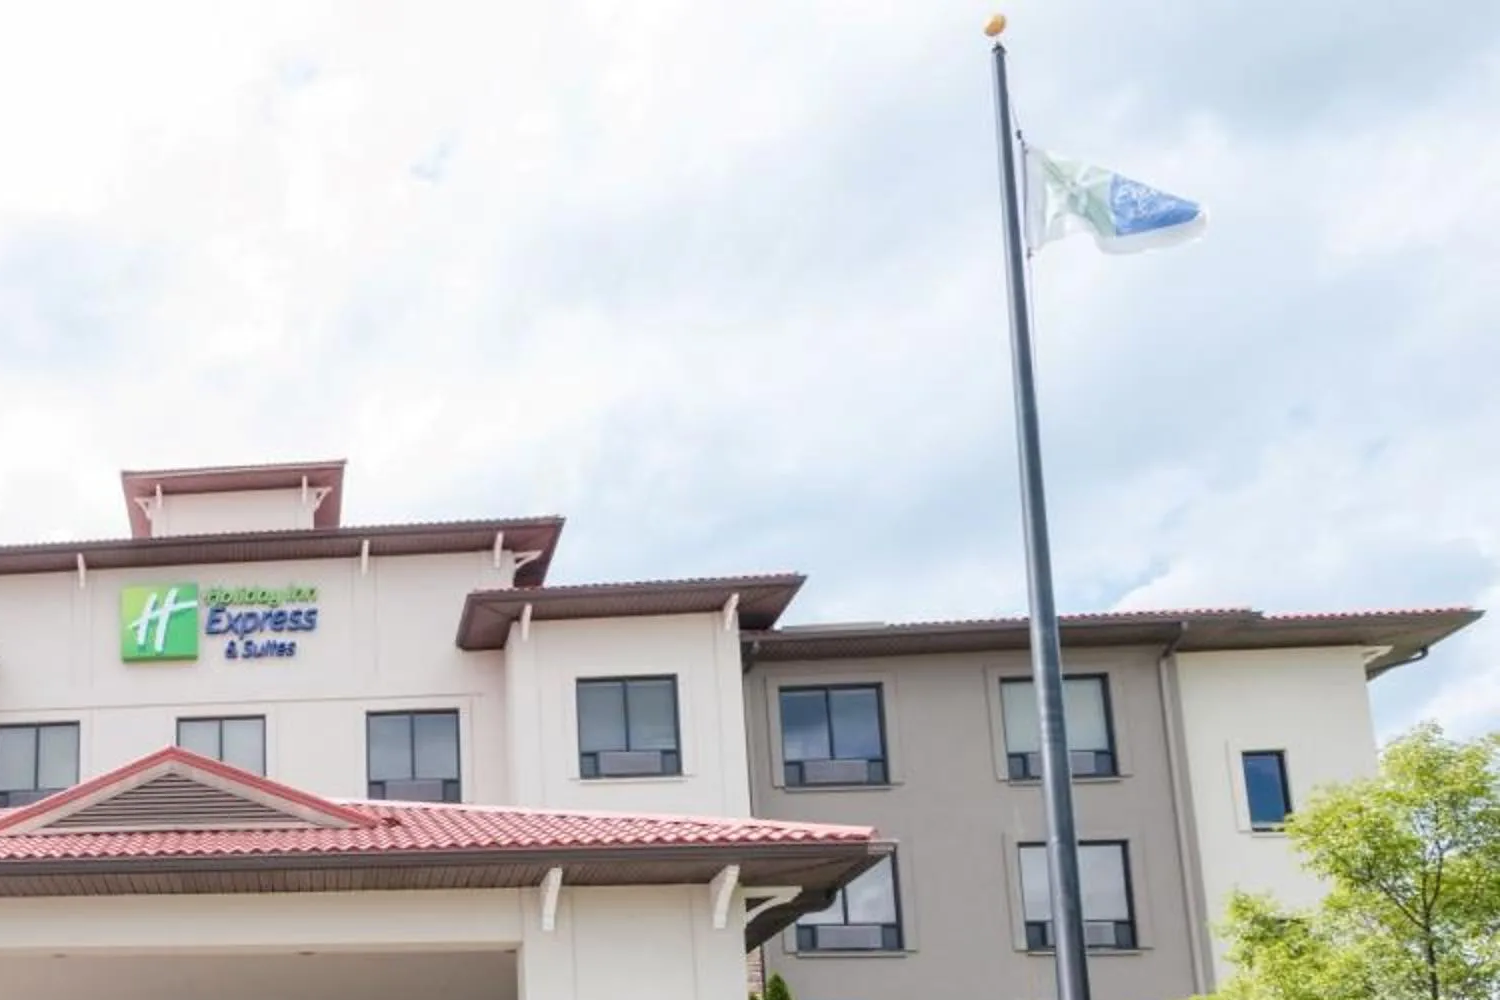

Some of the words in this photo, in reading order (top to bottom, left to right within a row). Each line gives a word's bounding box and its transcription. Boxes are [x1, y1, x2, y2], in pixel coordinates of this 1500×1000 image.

[205, 606, 318, 640] Express
[225, 640, 238, 659] &
[242, 639, 297, 658] Suites
